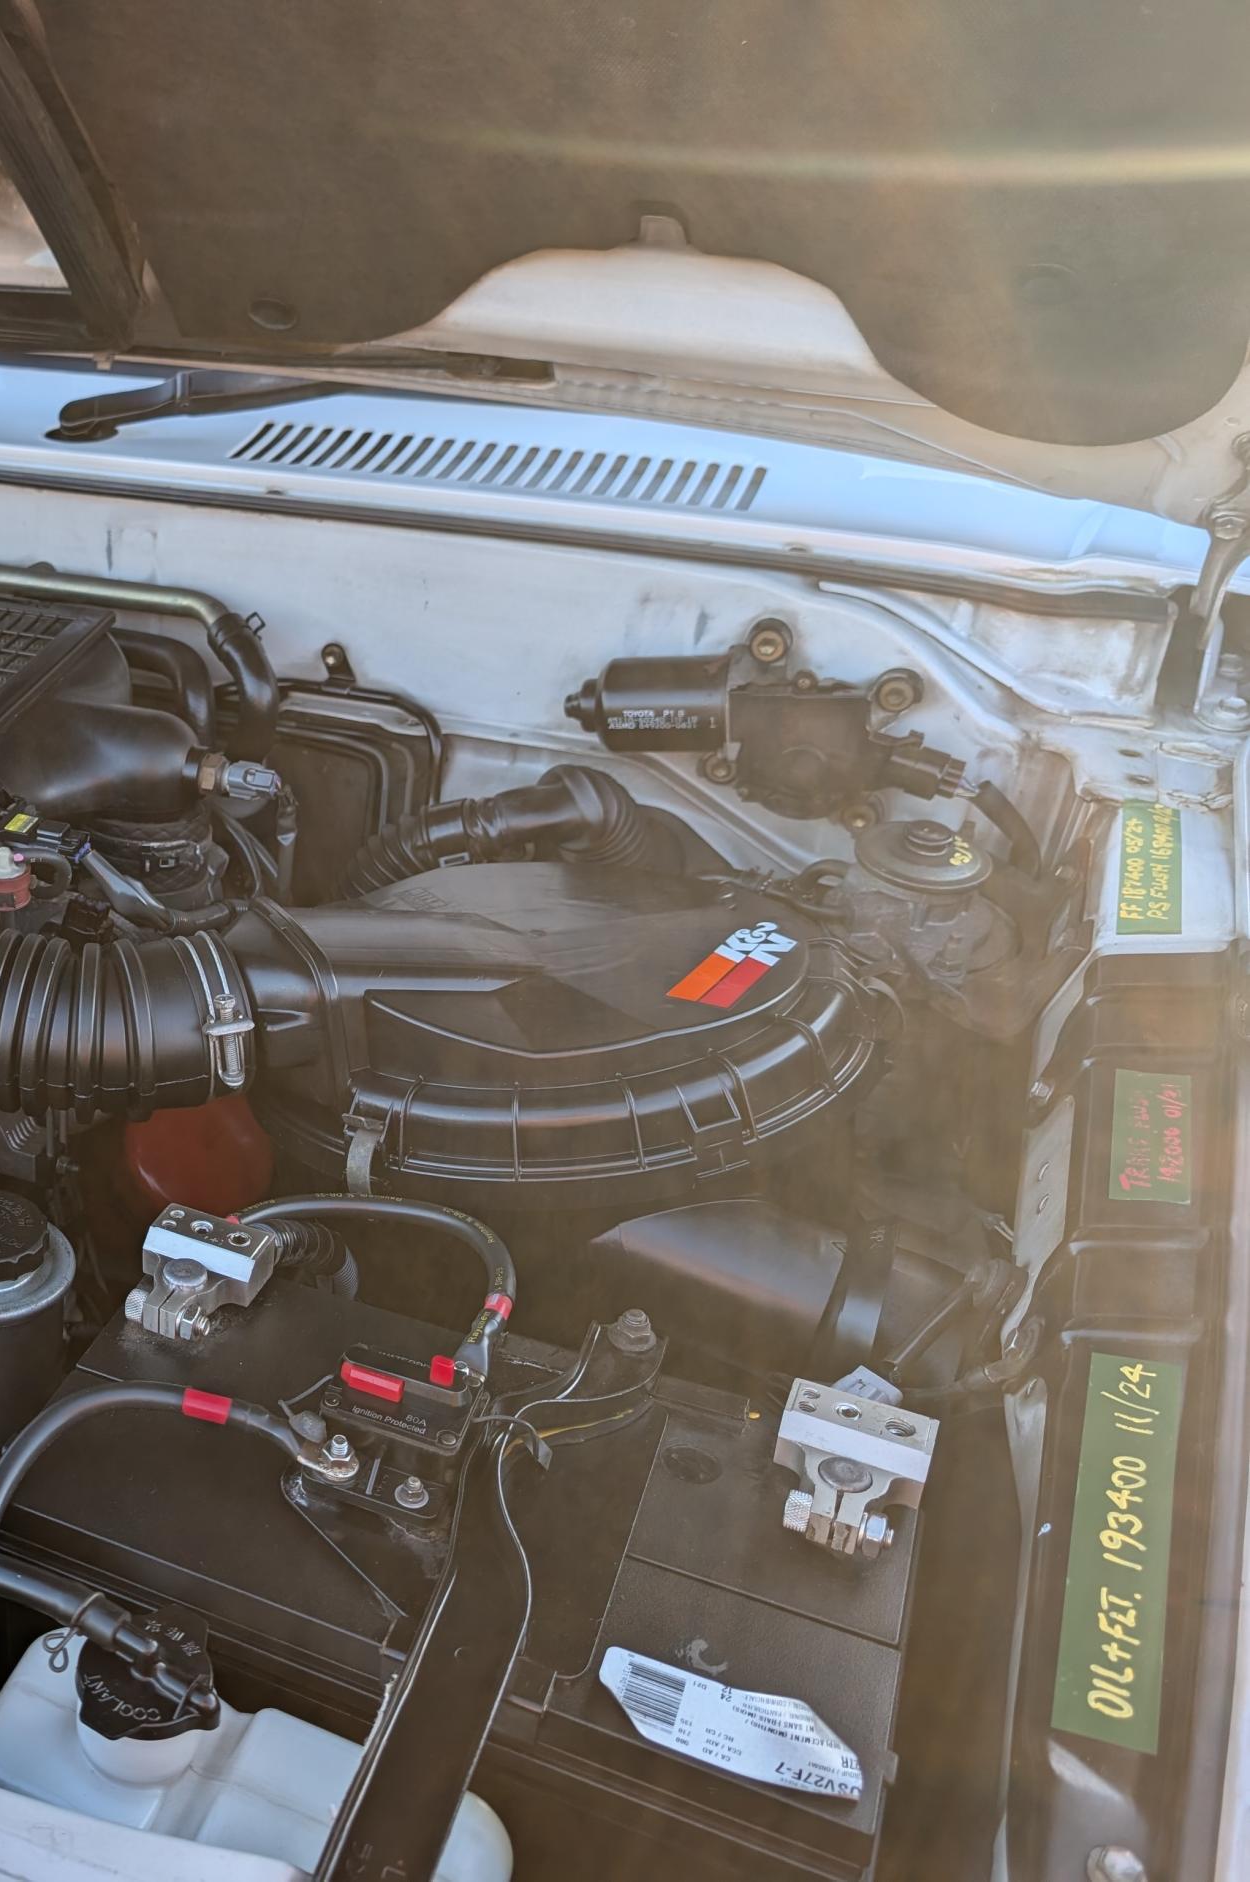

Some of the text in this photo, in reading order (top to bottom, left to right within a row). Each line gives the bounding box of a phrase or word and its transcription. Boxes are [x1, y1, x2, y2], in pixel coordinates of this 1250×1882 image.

[623, 709, 654, 718] TOYOTA
[713, 921, 798, 967] K&N
[1100, 1362, 1160, 1435] 11/24
[352, 1405, 427, 1436] Ignition Protected
[405, 1413, 427, 1427] 80A
[1100, 1455, 1148, 1571] 193400
[84, 1673, 161, 1721] COOLANT
[719, 1693, 733, 1704] 24
